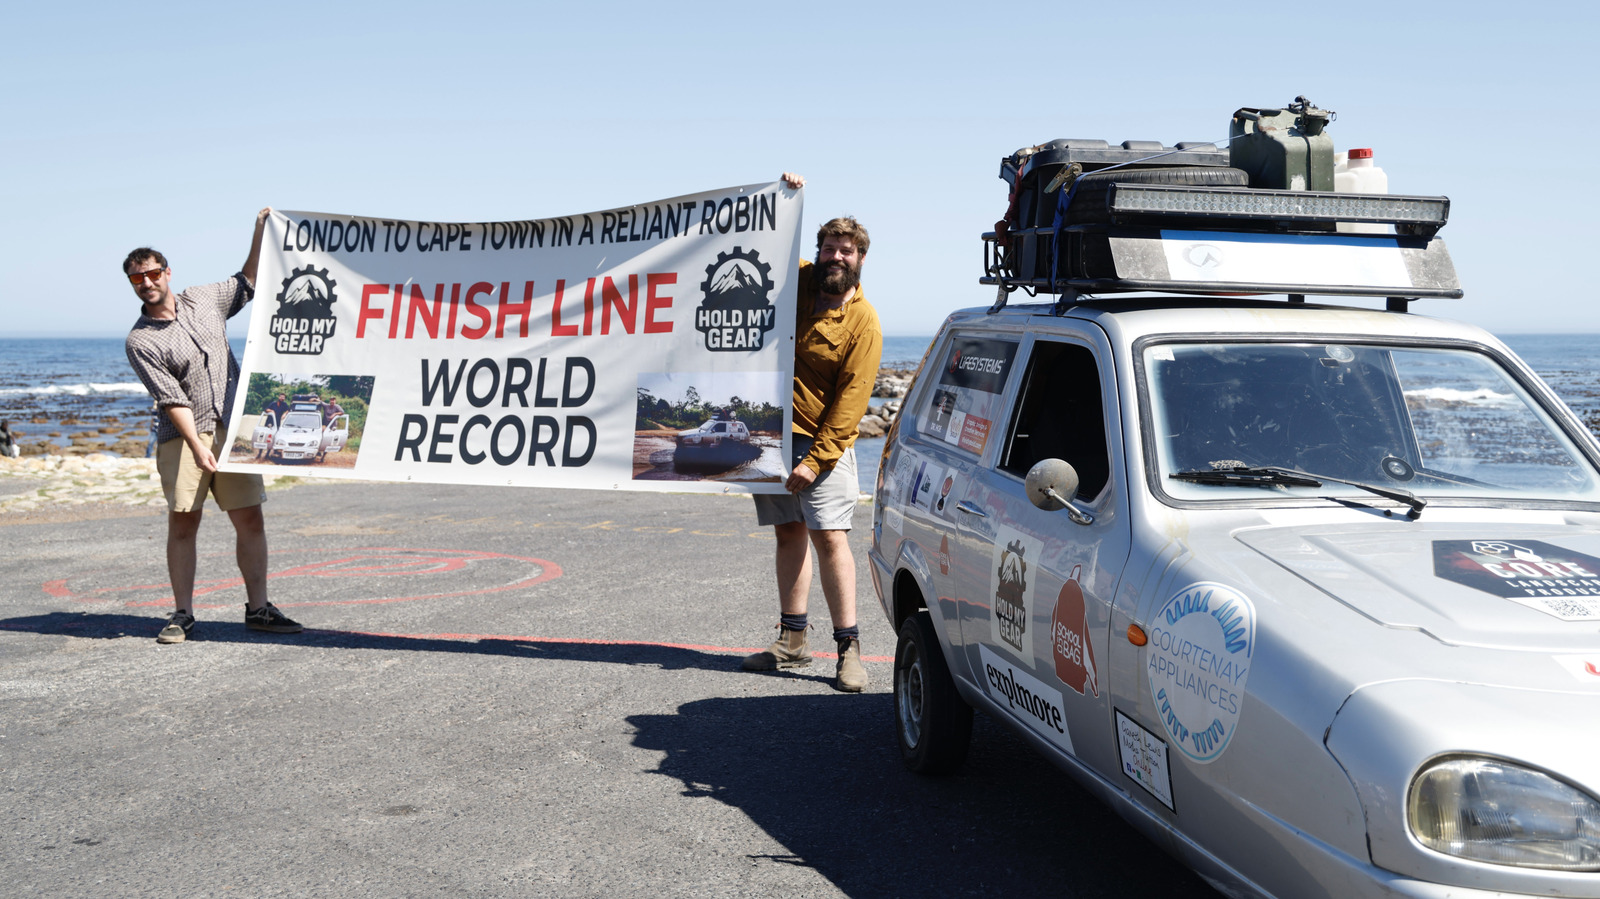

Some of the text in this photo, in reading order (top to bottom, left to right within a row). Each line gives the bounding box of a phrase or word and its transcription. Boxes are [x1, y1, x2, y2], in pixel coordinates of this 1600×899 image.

[283, 192, 777, 252] LONDON TO CAPE TOWN IN A RELIANT ROBIN
[356, 272, 678, 340] FINISH LINE
[698, 308, 773, 328] HOLD MY
[271, 317, 336, 334] HOLD MY
[707, 327, 761, 349] GEAR
[276, 333, 323, 352] GEAR
[421, 356, 596, 408] WORLD
[394, 413, 597, 468] RECORD
[1482, 562, 1598, 579] CORE
[996, 595, 1025, 629] HOLD MY
[1000, 618, 1022, 648] GEAR
[1057, 621, 1081, 649] SCHOOL
[1063, 640, 1081, 666] BAG
[1151, 627, 1247, 687] COURTENAY
[986, 663, 1064, 734] explmore
[1148, 652, 1238, 715] APPLIANCES
